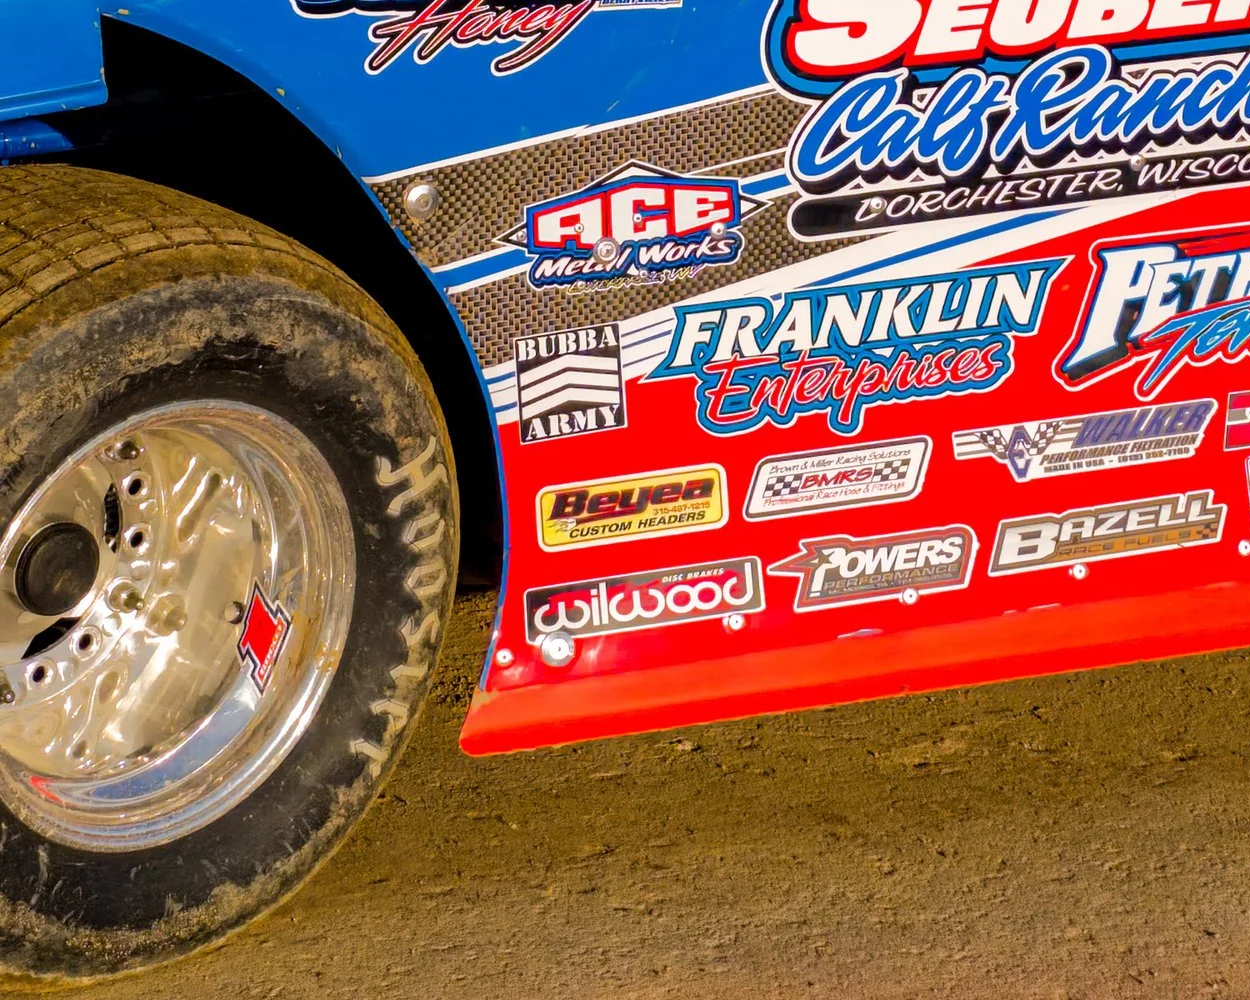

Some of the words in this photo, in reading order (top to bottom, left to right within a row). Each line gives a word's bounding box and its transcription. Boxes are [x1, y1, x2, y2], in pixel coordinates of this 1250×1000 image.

[800, 66, 1010, 175] Calf
[534, 186, 732, 250] ACE
[638, 235, 738, 264] Works
[669, 268, 1052, 368] FRANKLIN
[516, 324, 618, 363] BUBBA
[705, 341, 1002, 426] Enterprises
[523, 403, 622, 443] ARMY
[1071, 401, 1213, 449] WALKER
[836, 455, 867, 466] Racing
[867, 449, 911, 461] Solutions
[1039, 442, 1130, 466] PERFORMANCE
[1131, 434, 1199, 454] FILTRATION
[800, 467, 873, 490] BMRS
[547, 477, 715, 522] Beyea
[569, 521, 632, 539] CUSTOM
[637, 510, 707, 529] HEADERS
[998, 499, 1217, 566] BAZELL
[1058, 541, 1114, 557] RACE
[1124, 531, 1191, 548] FUELS
[661, 573, 684, 584] DISC
[687, 568, 725, 580] BRAKES
[809, 536, 963, 597] POWERS
[823, 563, 959, 591] PERFORMANCE
[534, 562, 754, 632] wilwood
